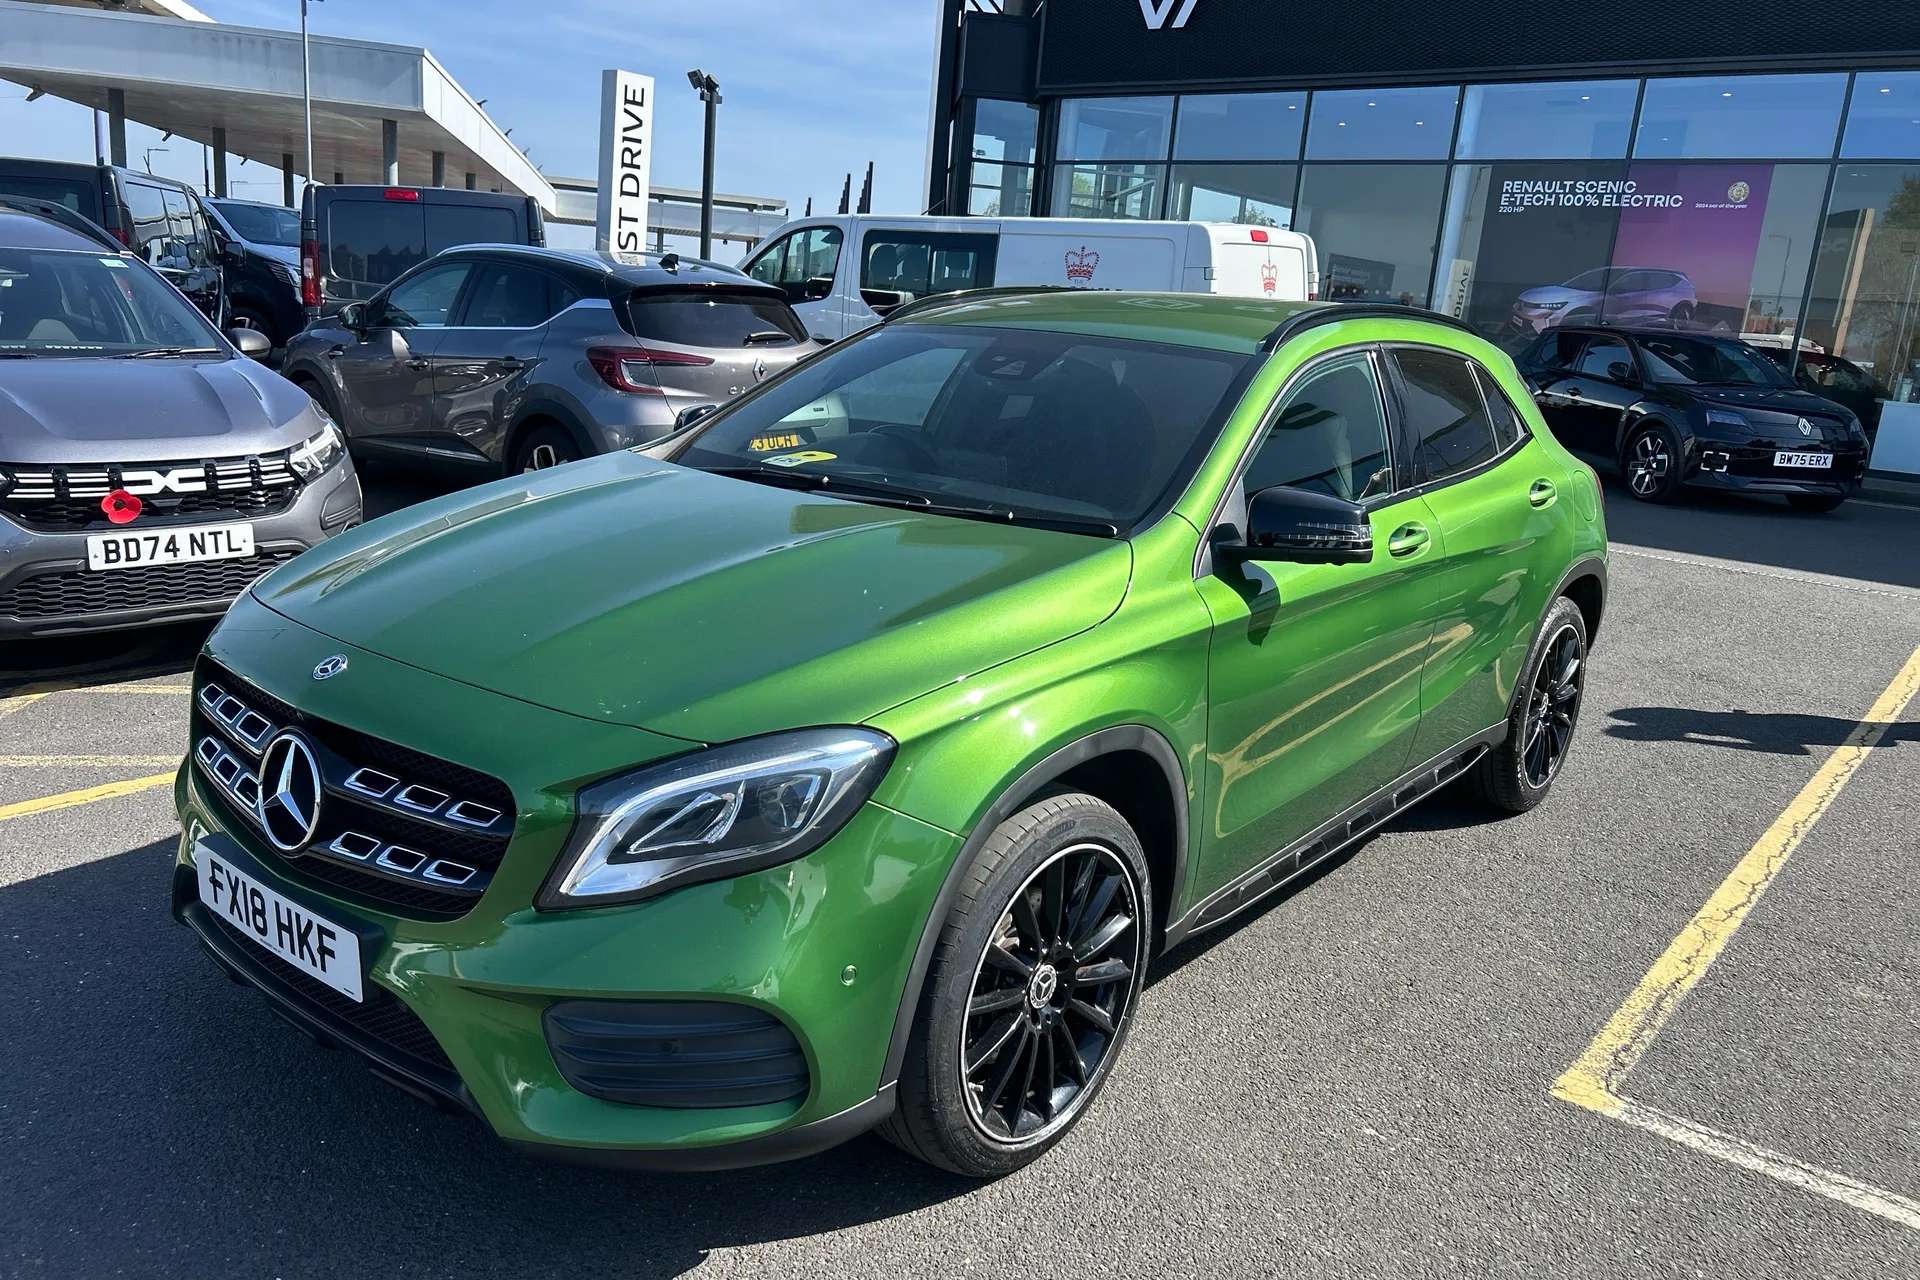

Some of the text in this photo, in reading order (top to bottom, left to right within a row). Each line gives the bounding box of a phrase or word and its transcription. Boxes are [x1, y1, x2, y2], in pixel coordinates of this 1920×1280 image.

[617, 84, 645, 251] ST DRIVE
[1502, 181, 1637, 194] RENAULT SCENIC
[1500, 193, 1683, 207] E-TECH 100% ELECTRIC
[1779, 454, 1829, 466] BW75 ERX
[102, 530, 243, 564] BD74 NTL
[208, 857, 337, 973] FX18 HKF
